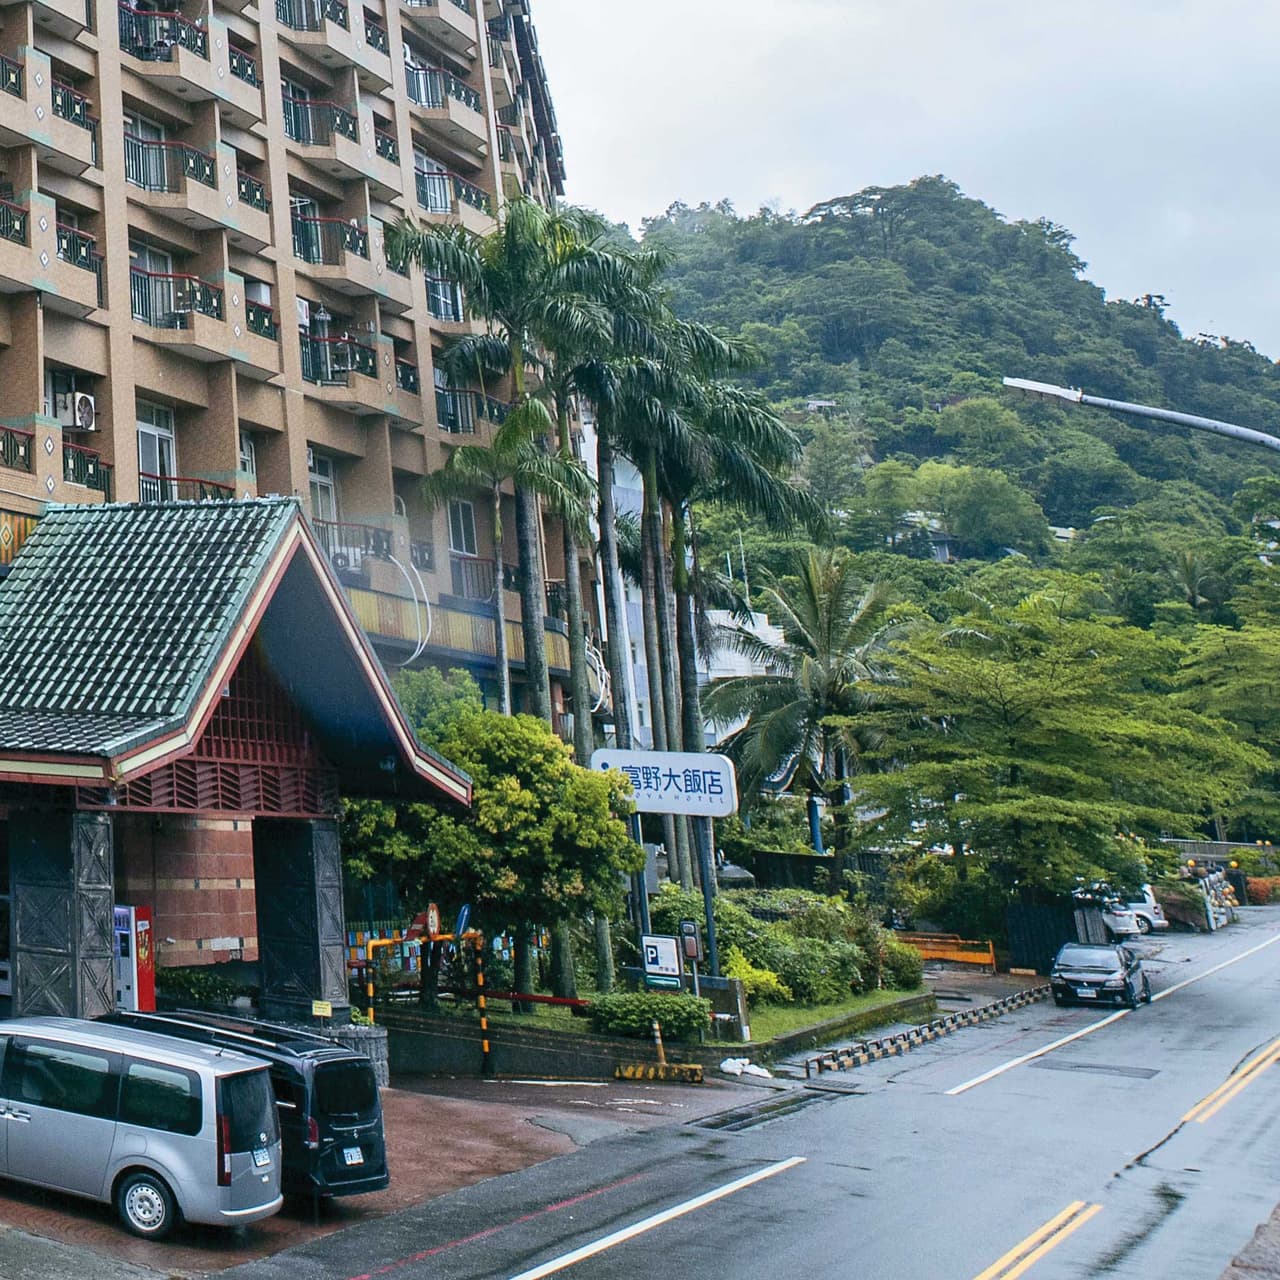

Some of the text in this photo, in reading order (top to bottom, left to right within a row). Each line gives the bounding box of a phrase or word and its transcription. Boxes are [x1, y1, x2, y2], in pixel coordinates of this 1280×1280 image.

[621, 765, 724, 795] 富野大飯店
[647, 947, 657, 963] P
